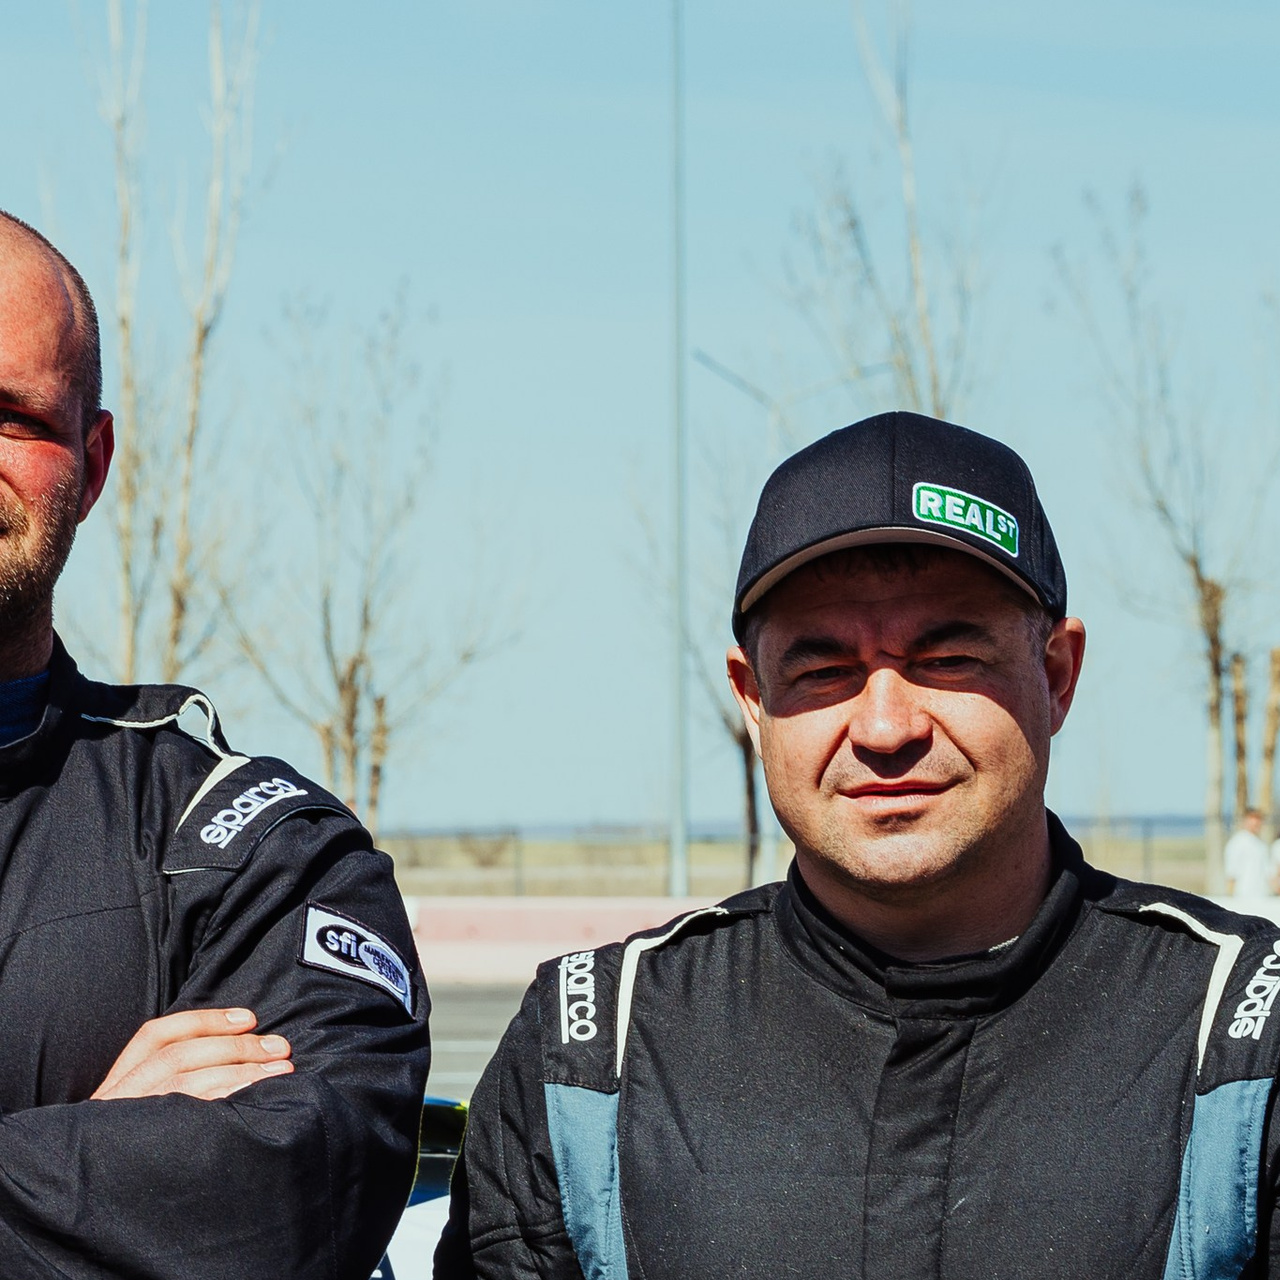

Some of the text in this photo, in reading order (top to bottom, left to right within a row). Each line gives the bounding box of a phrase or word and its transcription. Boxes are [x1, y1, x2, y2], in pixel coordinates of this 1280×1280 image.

[200, 777, 308, 849] sparco
[325, 930, 357, 958] sfi
[558, 950, 598, 1044] sparco
[1227, 939, 1280, 1040] sparc
